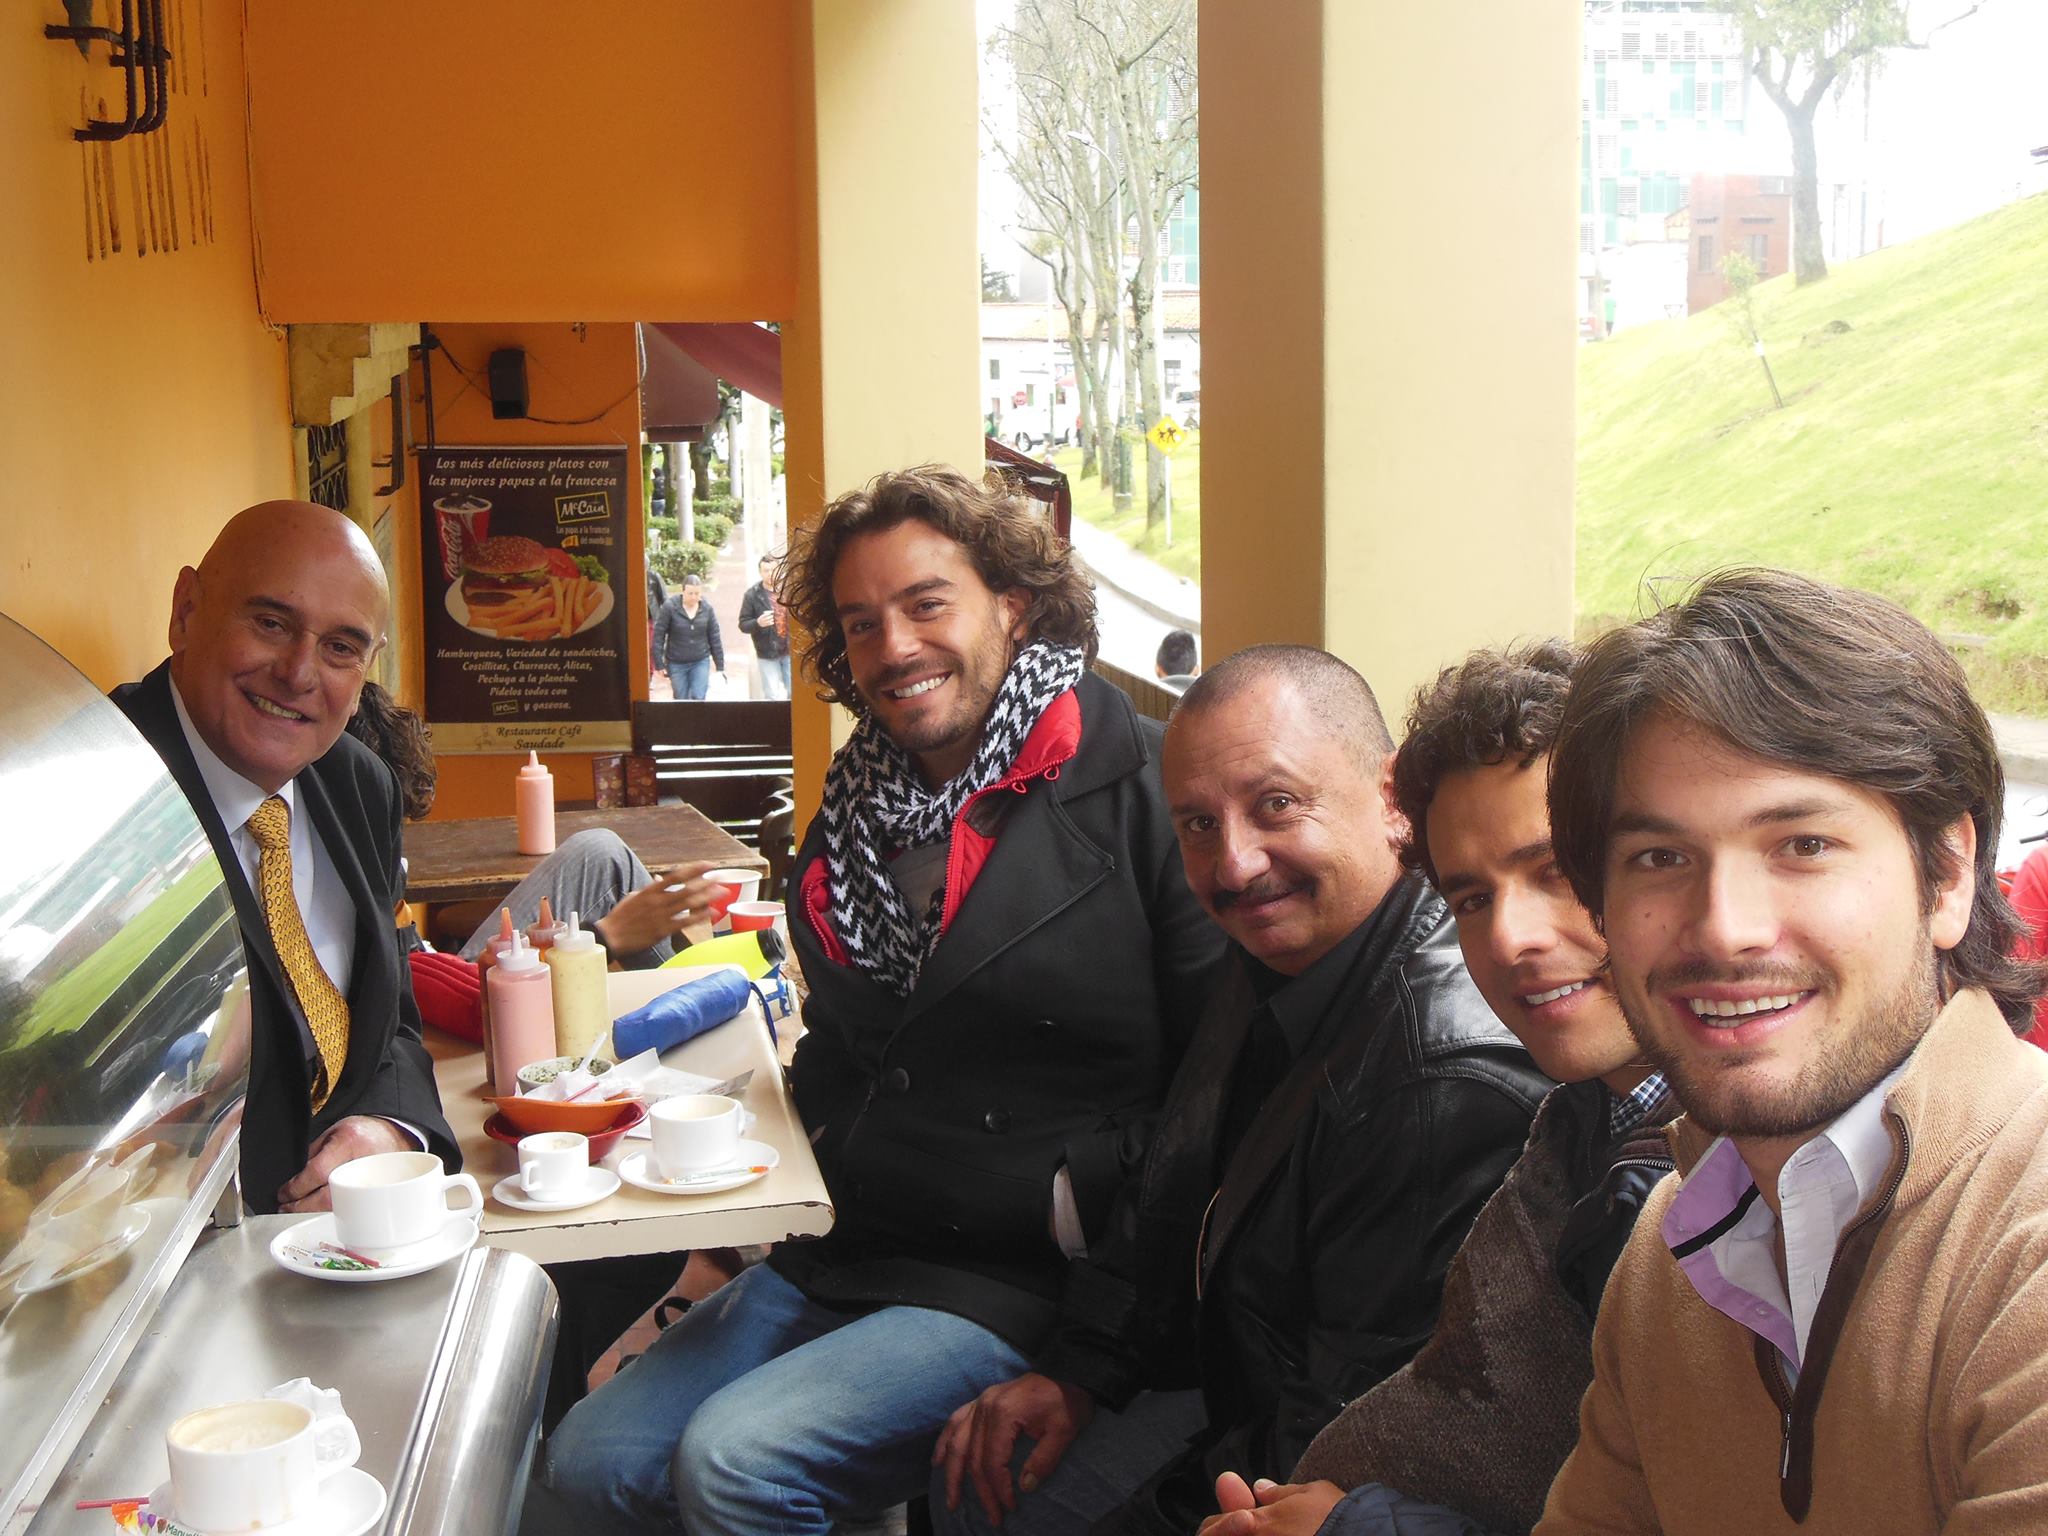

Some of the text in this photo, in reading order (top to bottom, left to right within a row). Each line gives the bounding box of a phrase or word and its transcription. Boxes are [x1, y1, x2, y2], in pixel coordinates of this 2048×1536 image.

[437, 458, 609, 471] Los más deliciosos platos con
[429, 475, 616, 488] las mejores papas a la francesa
[561, 501, 606, 517] McCain
[506, 649, 546, 657] Variedad
[550, 648, 560, 657] de
[563, 648, 617, 657] sandwiches,
[462, 661, 593, 671] Costillitas, Churrasco, Alitas,
[478, 674, 516, 684] Pechuga
[528, 674, 537, 682] la
[539, 674, 577, 684] plancha.
[525, 687, 548, 695] todos
[532, 701, 571, 710] gaseosa.
[497, 725, 582, 737] Restaurante Café
[514, 737, 565, 750] Saudade
